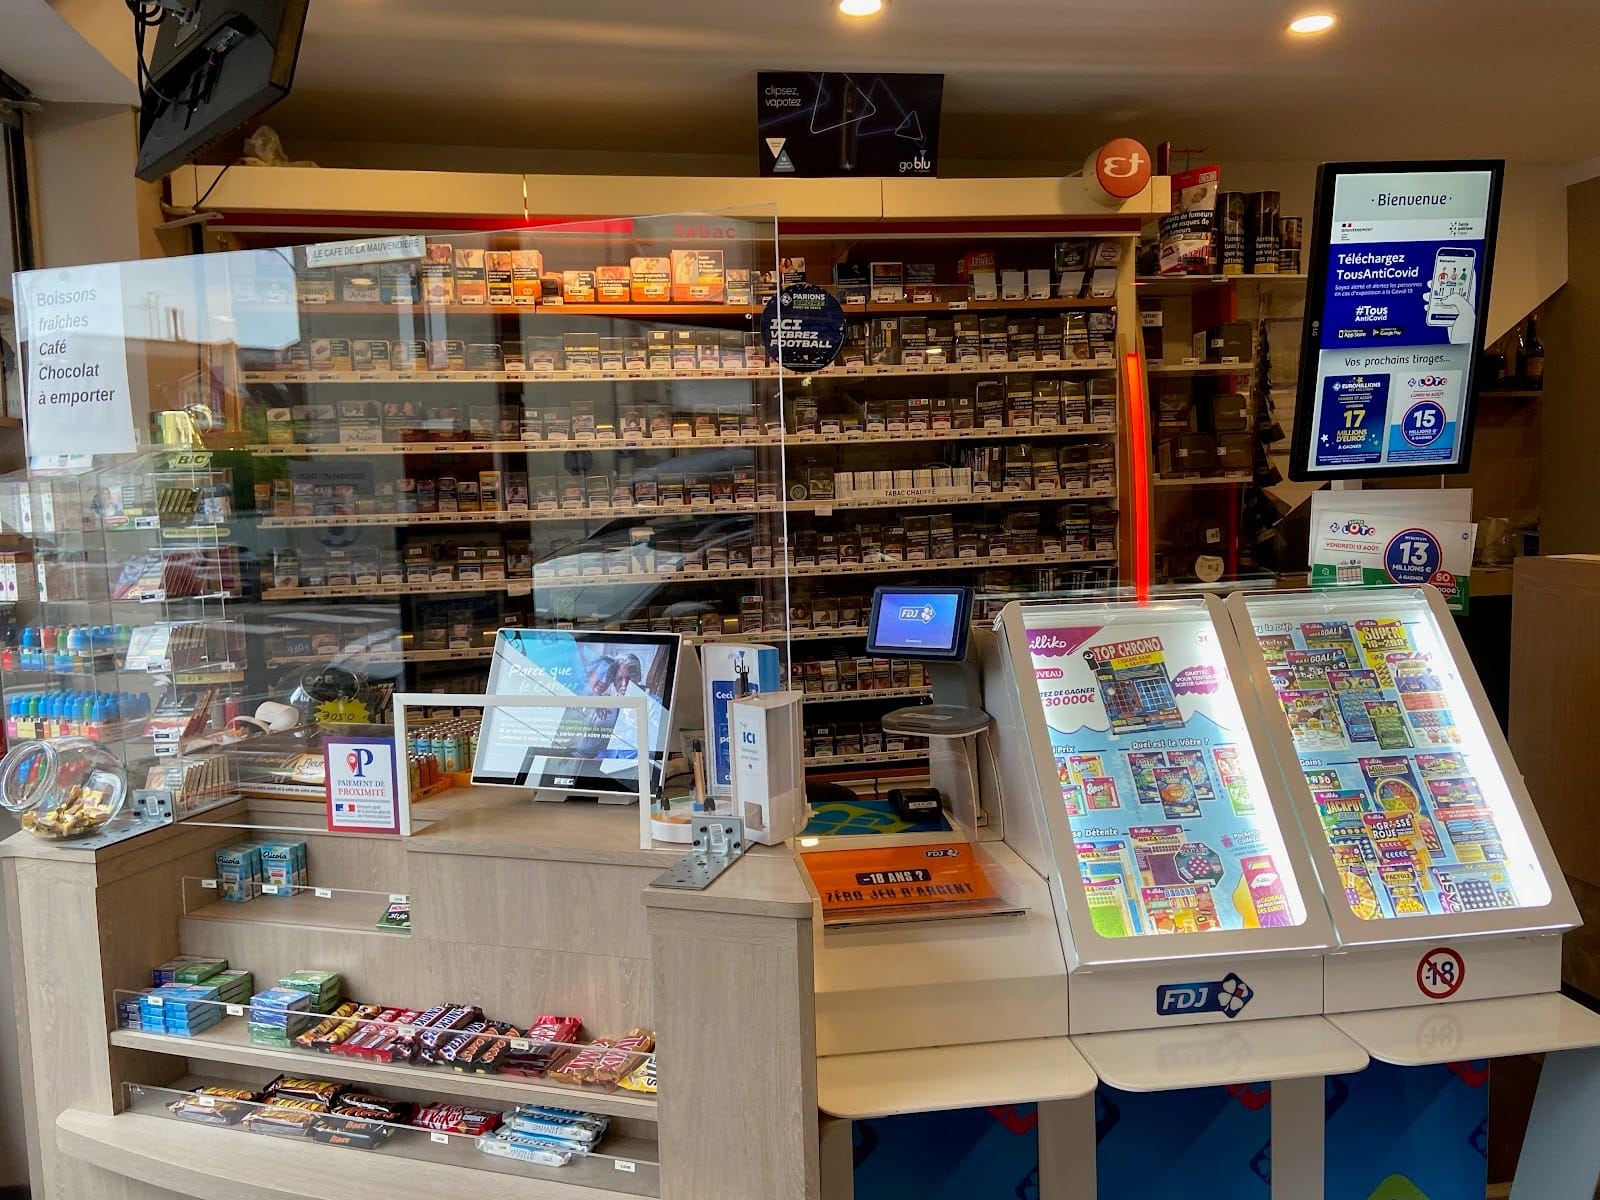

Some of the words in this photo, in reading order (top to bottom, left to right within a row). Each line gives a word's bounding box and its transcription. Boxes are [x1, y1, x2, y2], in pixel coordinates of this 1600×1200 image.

[765, 86, 799, 96] clipsez,
[765, 98, 801, 108] vapotez
[900, 162, 912, 172] go
[914, 156, 930, 169] blu
[1378, 194, 1447, 206] Bienvenue
[676, 224, 736, 239] tabac
[325, 248, 343, 256] CAFE
[1338, 253, 1405, 265] Téléchargez
[1337, 267, 1419, 280] TousAntiCovid
[37, 288, 96, 307] Boissons
[1356, 306, 1388, 315] #Tous
[38, 313, 89, 331] fraîches
[1355, 314, 1387, 322] AntiCovid
[770, 319, 802, 330] ICI
[770, 331, 819, 339] VIBREZ
[39, 340, 66, 357] Café
[770, 340, 832, 348] FOOTBALL
[1345, 357, 1361, 366] Vos
[1365, 356, 1409, 367] prochains
[38, 363, 100, 381] Chocolat
[1418, 375, 1448, 386] LOTO
[38, 391, 47, 404] à
[50, 389, 115, 407] emporter
[1344, 410, 1366, 427] 17
[1413, 410, 1436, 427] 15
[178, 454, 206, 464] BIC
[1342, 524, 1376, 536] LOTO
[1400, 542, 1429, 565] 13
[1392, 564, 1425, 572] MILLIONS
[1435, 573, 1450, 581] 50
[901, 609, 918, 617] FDJ
[1321, 628, 1339, 636] GOAL
[1363, 627, 1401, 639] SUPER
[1029, 635, 1067, 650] illiko
[1096, 647, 1116, 661] TOP
[1118, 638, 1161, 656] CHRONO
[1310, 654, 1331, 663] GOAL
[509, 664, 545, 677] Parce
[549, 665, 572, 680] que
[734, 659, 750, 674] blu
[1045, 696, 1060, 706] 30
[1061, 694, 1095, 706] 000€
[742, 732, 756, 744] ICI
[1132, 740, 1151, 750] Quel
[1180, 738, 1200, 746] Vôtre
[338, 787, 385, 796] PROXIMITÉ
[1326, 799, 1363, 813] JACKPOT
[1085, 827, 1118, 837] Détente
[1373, 829, 1397, 839] ROUE
[218, 856, 240, 864] Ricola
[263, 851, 287, 859] Ricola
[863, 873, 885, 884] -18
[889, 871, 913, 883] ANS
[916, 870, 924, 881] ?
[825, 888, 864, 902] ZÉRO
[870, 888, 897, 900] JEU
[901, 884, 974, 898] D'ARGENT
[1438, 872, 1462, 913] CASH
[1425, 960, 1455, 988] -18
[1163, 988, 1209, 1010] FDJ
[430, 1111, 461, 1125] KitKat
